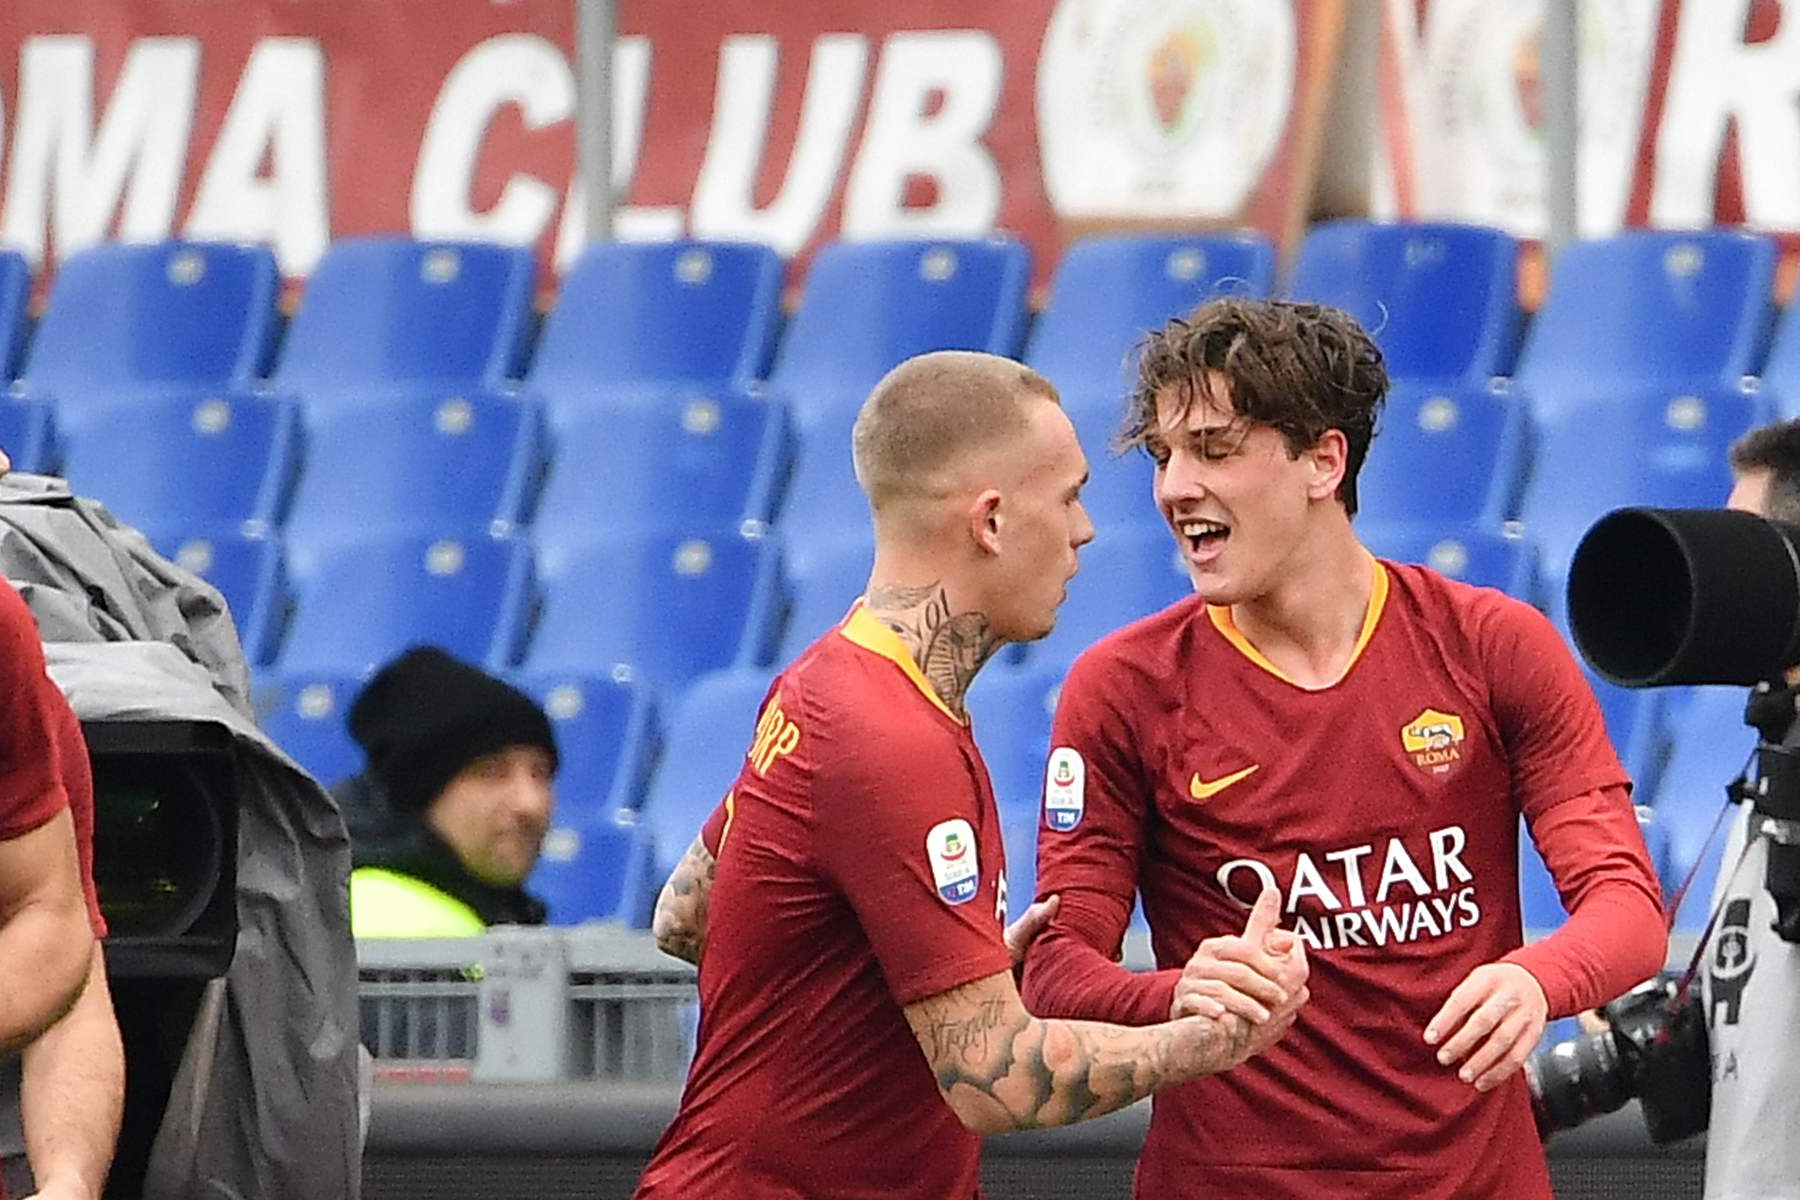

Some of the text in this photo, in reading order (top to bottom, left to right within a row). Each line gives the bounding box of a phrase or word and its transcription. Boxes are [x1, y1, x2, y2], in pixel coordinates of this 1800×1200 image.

[409, 30, 1003, 277] CLUB
[1216, 825, 1474, 914] QATAR
[1291, 886, 1480, 950] AIRWAYS
